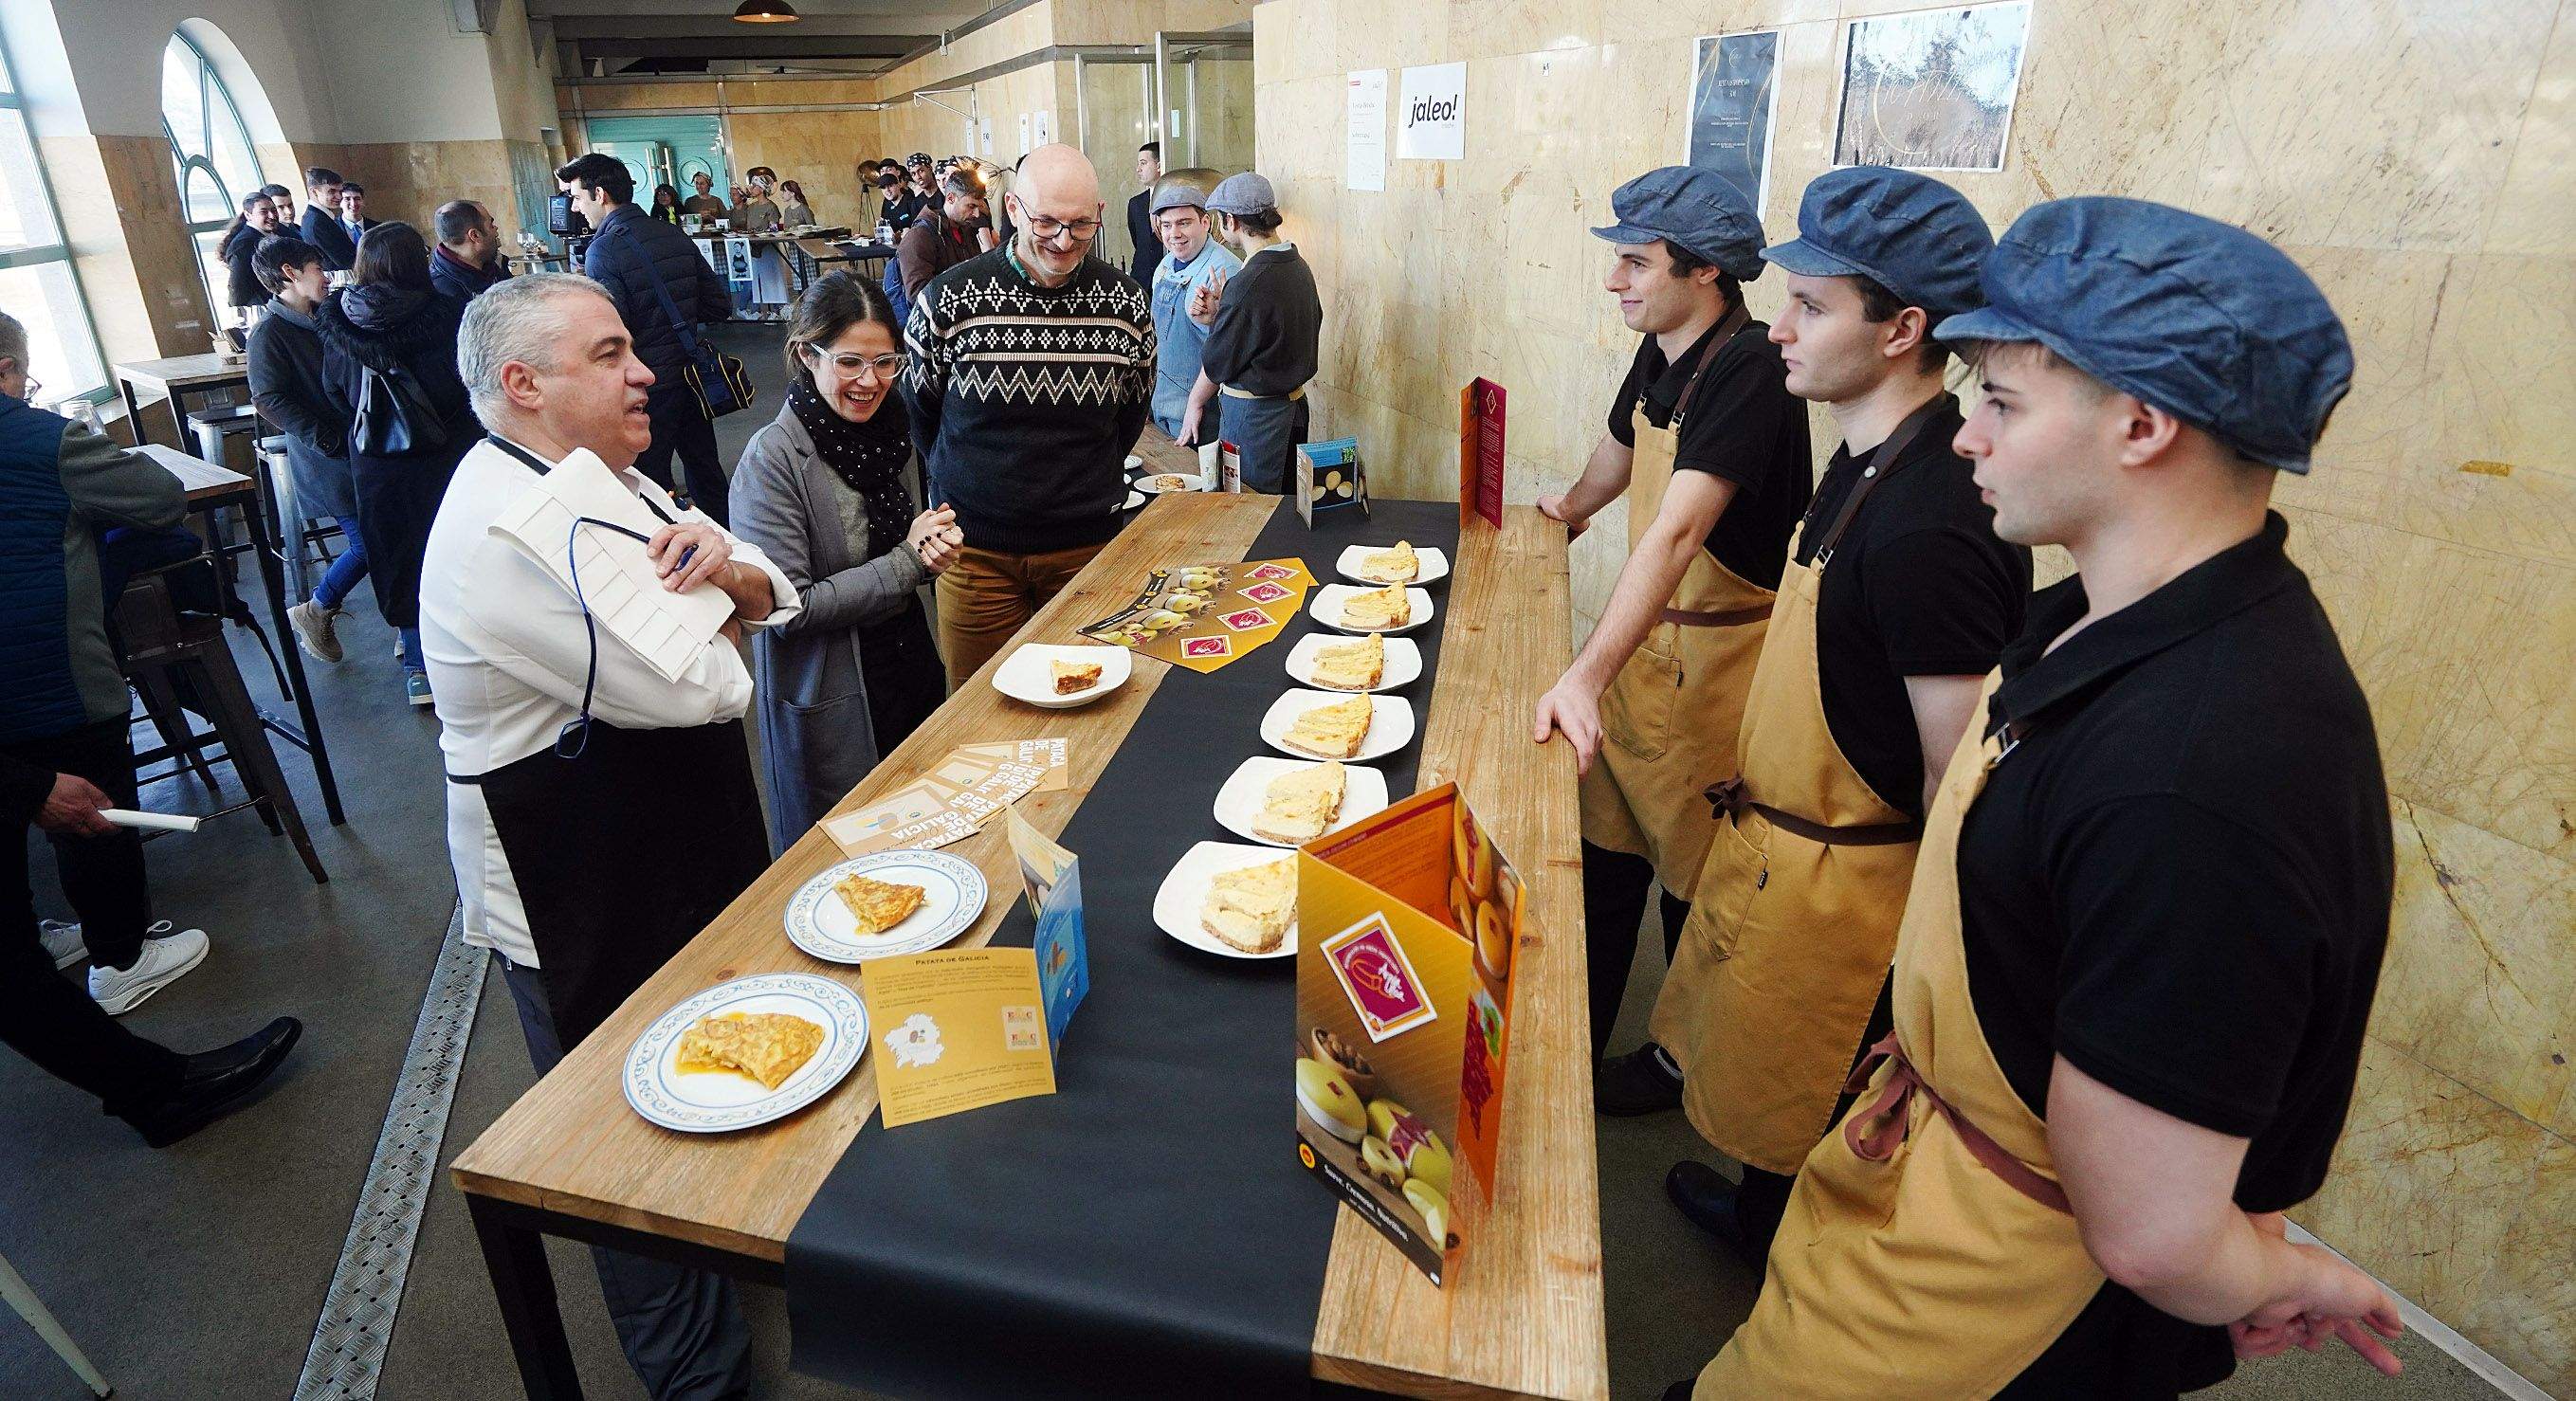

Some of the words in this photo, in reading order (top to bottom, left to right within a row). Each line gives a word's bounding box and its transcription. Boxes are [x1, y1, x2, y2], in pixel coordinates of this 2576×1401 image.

[1408, 94, 1457, 128] jaleo!
[890, 810, 959, 840] GALICIA
[942, 817, 968, 832] DE
